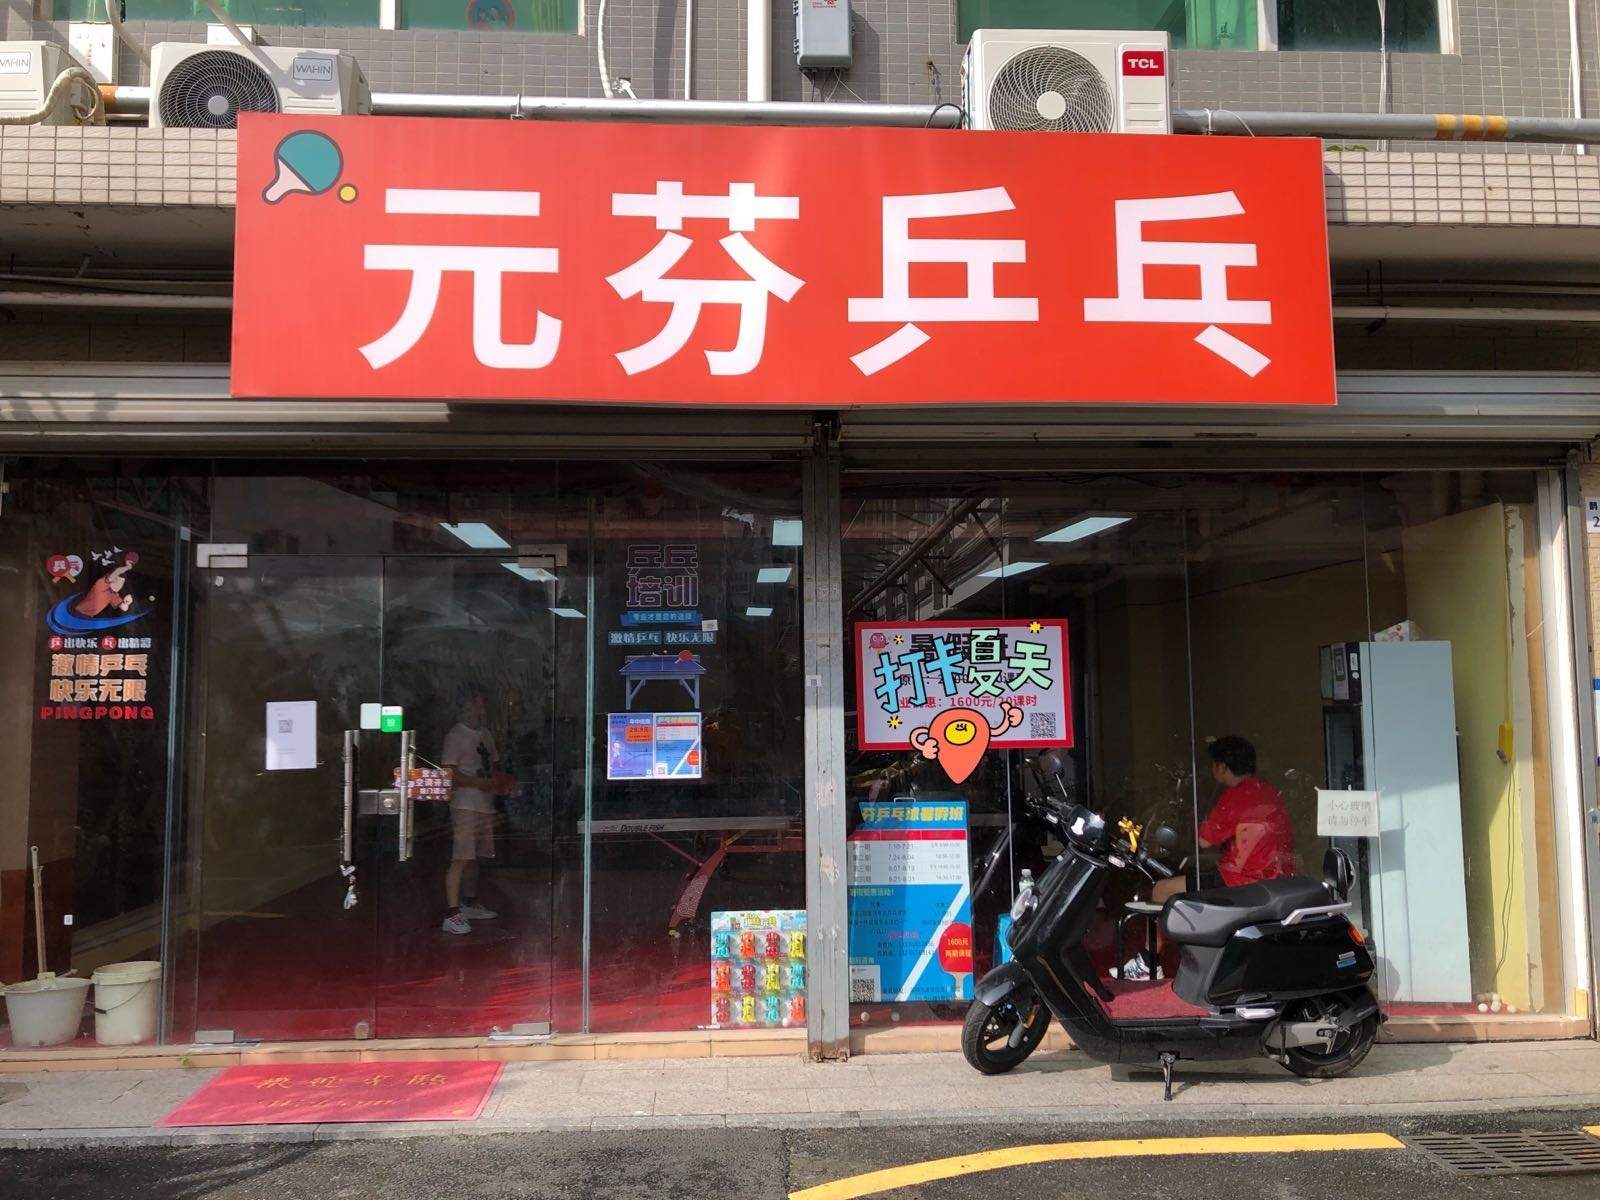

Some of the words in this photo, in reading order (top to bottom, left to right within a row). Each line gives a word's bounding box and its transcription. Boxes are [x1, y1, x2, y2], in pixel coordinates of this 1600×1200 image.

[295, 64, 331, 75] WAHIN
[1127, 58, 1159, 69] TCL
[358, 180, 1273, 378] 元芬乒乓
[625, 544, 699, 575] 乒乓
[626, 575, 699, 607] 培训
[610, 632, 659, 644] 激情乒乓
[665, 631, 714, 643] 快乐无限
[51, 653, 148, 677] 激情乒乓
[49, 678, 147, 702] 快乐无限
[41, 706, 154, 720] PINGPONG
